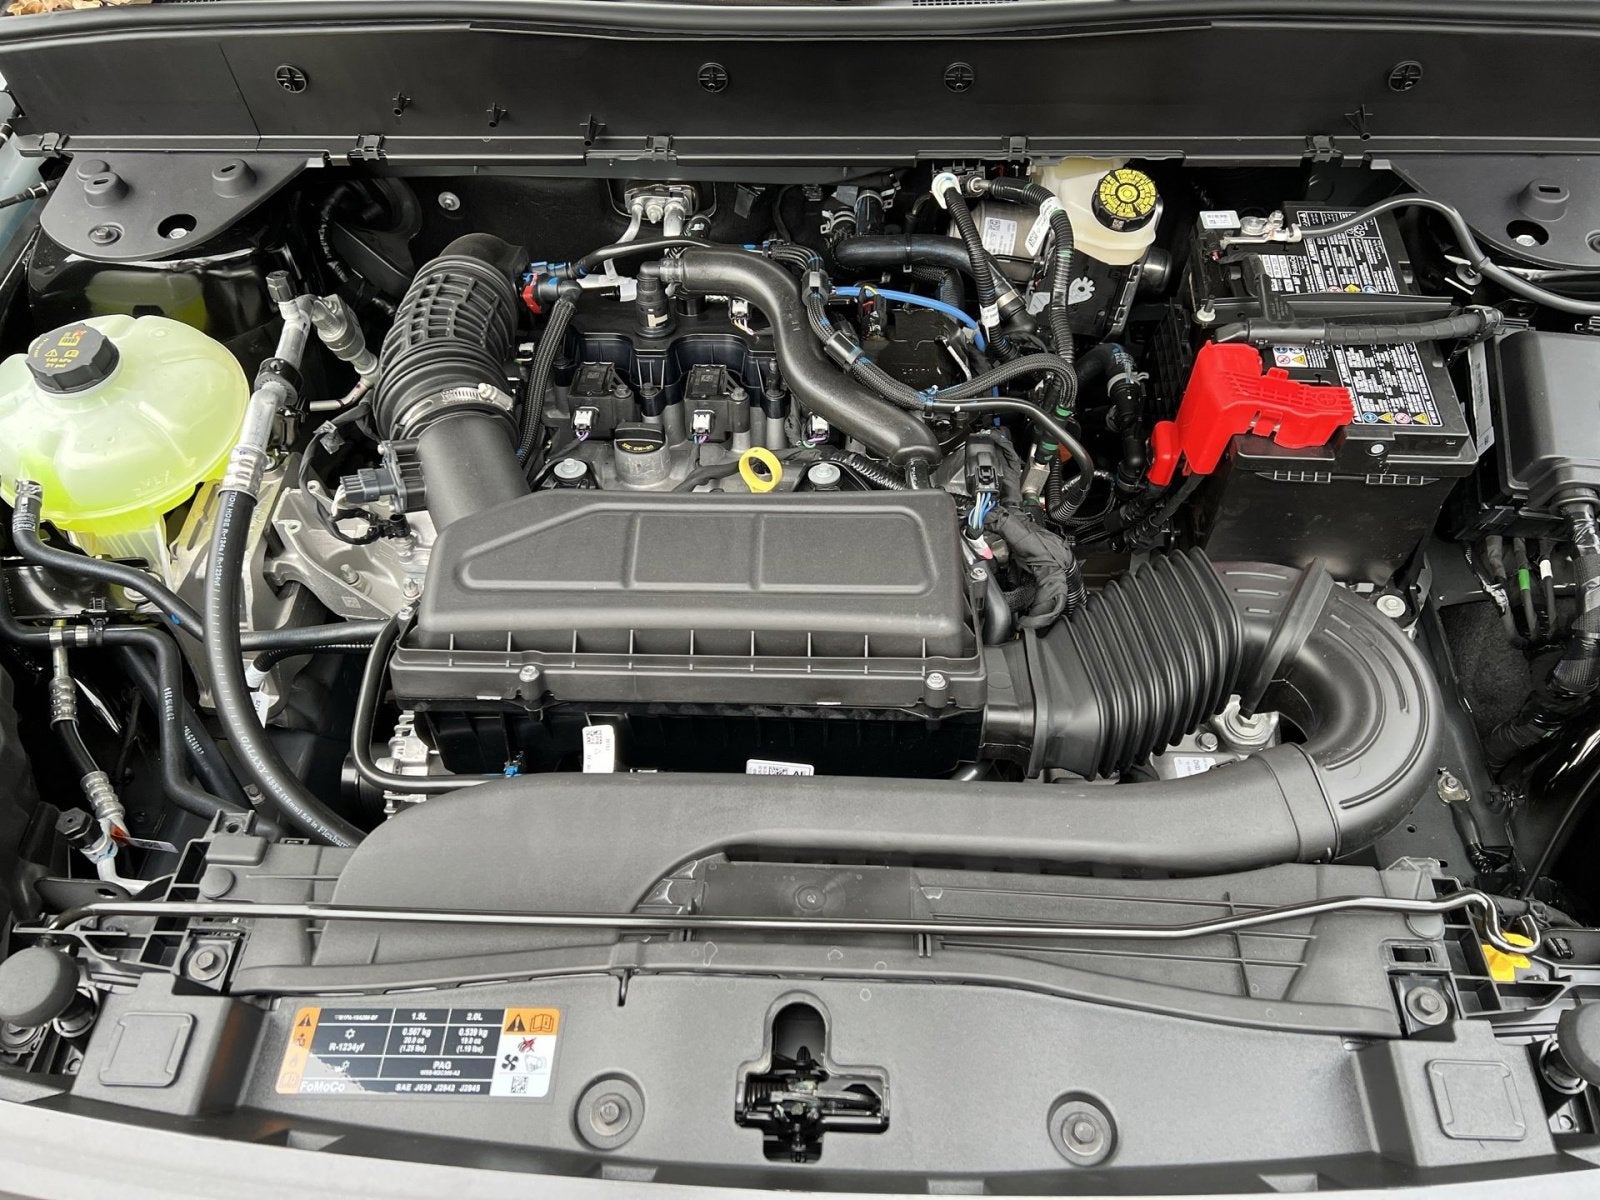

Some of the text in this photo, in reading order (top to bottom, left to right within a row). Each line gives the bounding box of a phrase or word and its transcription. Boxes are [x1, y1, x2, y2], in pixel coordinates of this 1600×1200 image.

[223, 508, 233, 527] HOSE
[218, 528, 229, 551] R-134a
[240, 736, 268, 773] GALAXY
[317, 825, 351, 848] Flexbarr
[411, 1012, 427, 1021] 1.5L
[466, 1012, 483, 1021] 2.0L
[402, 1027, 432, 1038] 0.567 kg
[458, 1027, 489, 1039] 0.539 kg
[328, 1042, 366, 1053] R-1234yf
[432, 1060, 452, 1070] PAG
[300, 1081, 346, 1092] FoMoCo
[395, 1083, 412, 1092] SAE
[413, 1083, 432, 1092] J639
